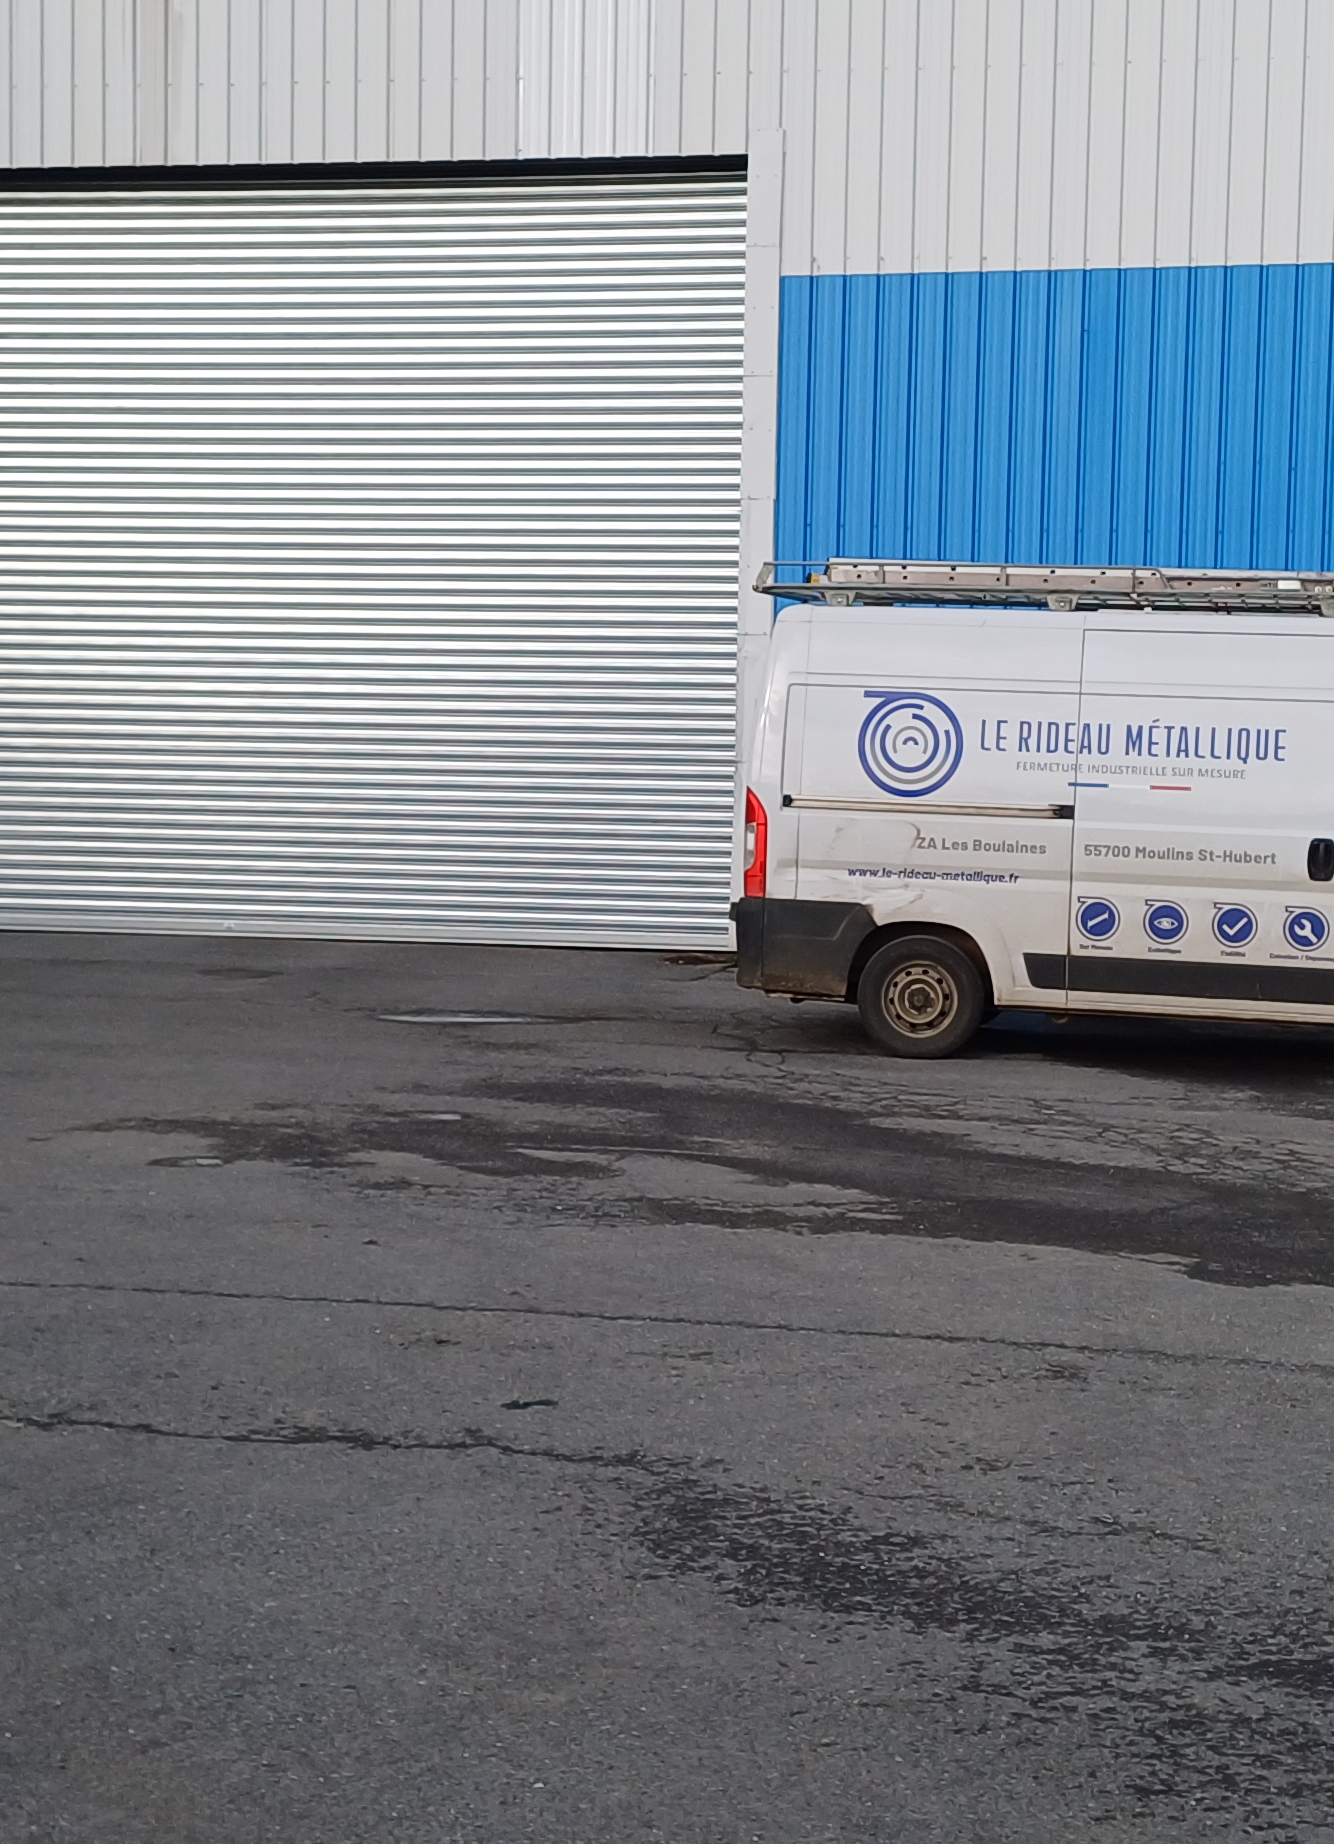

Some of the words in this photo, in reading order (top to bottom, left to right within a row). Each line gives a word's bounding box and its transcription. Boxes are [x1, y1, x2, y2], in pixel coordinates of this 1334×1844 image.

[979, 718, 1009, 752] LE
[1017, 720, 1111, 756] RIDEAU
[1124, 718, 1287, 765] MÉTALLIQUE
[1016, 761, 1084, 774] FERMETURE
[1087, 763, 1168, 777] INDUSTRIELLE
[1171, 766, 1194, 778] SUR
[1197, 767, 1247, 780] MESURE
[917, 836, 937, 850] ZA
[941, 837, 968, 851] Les
[972, 839, 1047, 855] Boulaines
[1083, 843, 1131, 858] 55700
[1134, 846, 1194, 861] Moulins
[1198, 848, 1277, 865] St-Hubert
[847, 867, 1020, 885] www.le-rideau-metallique.fr
